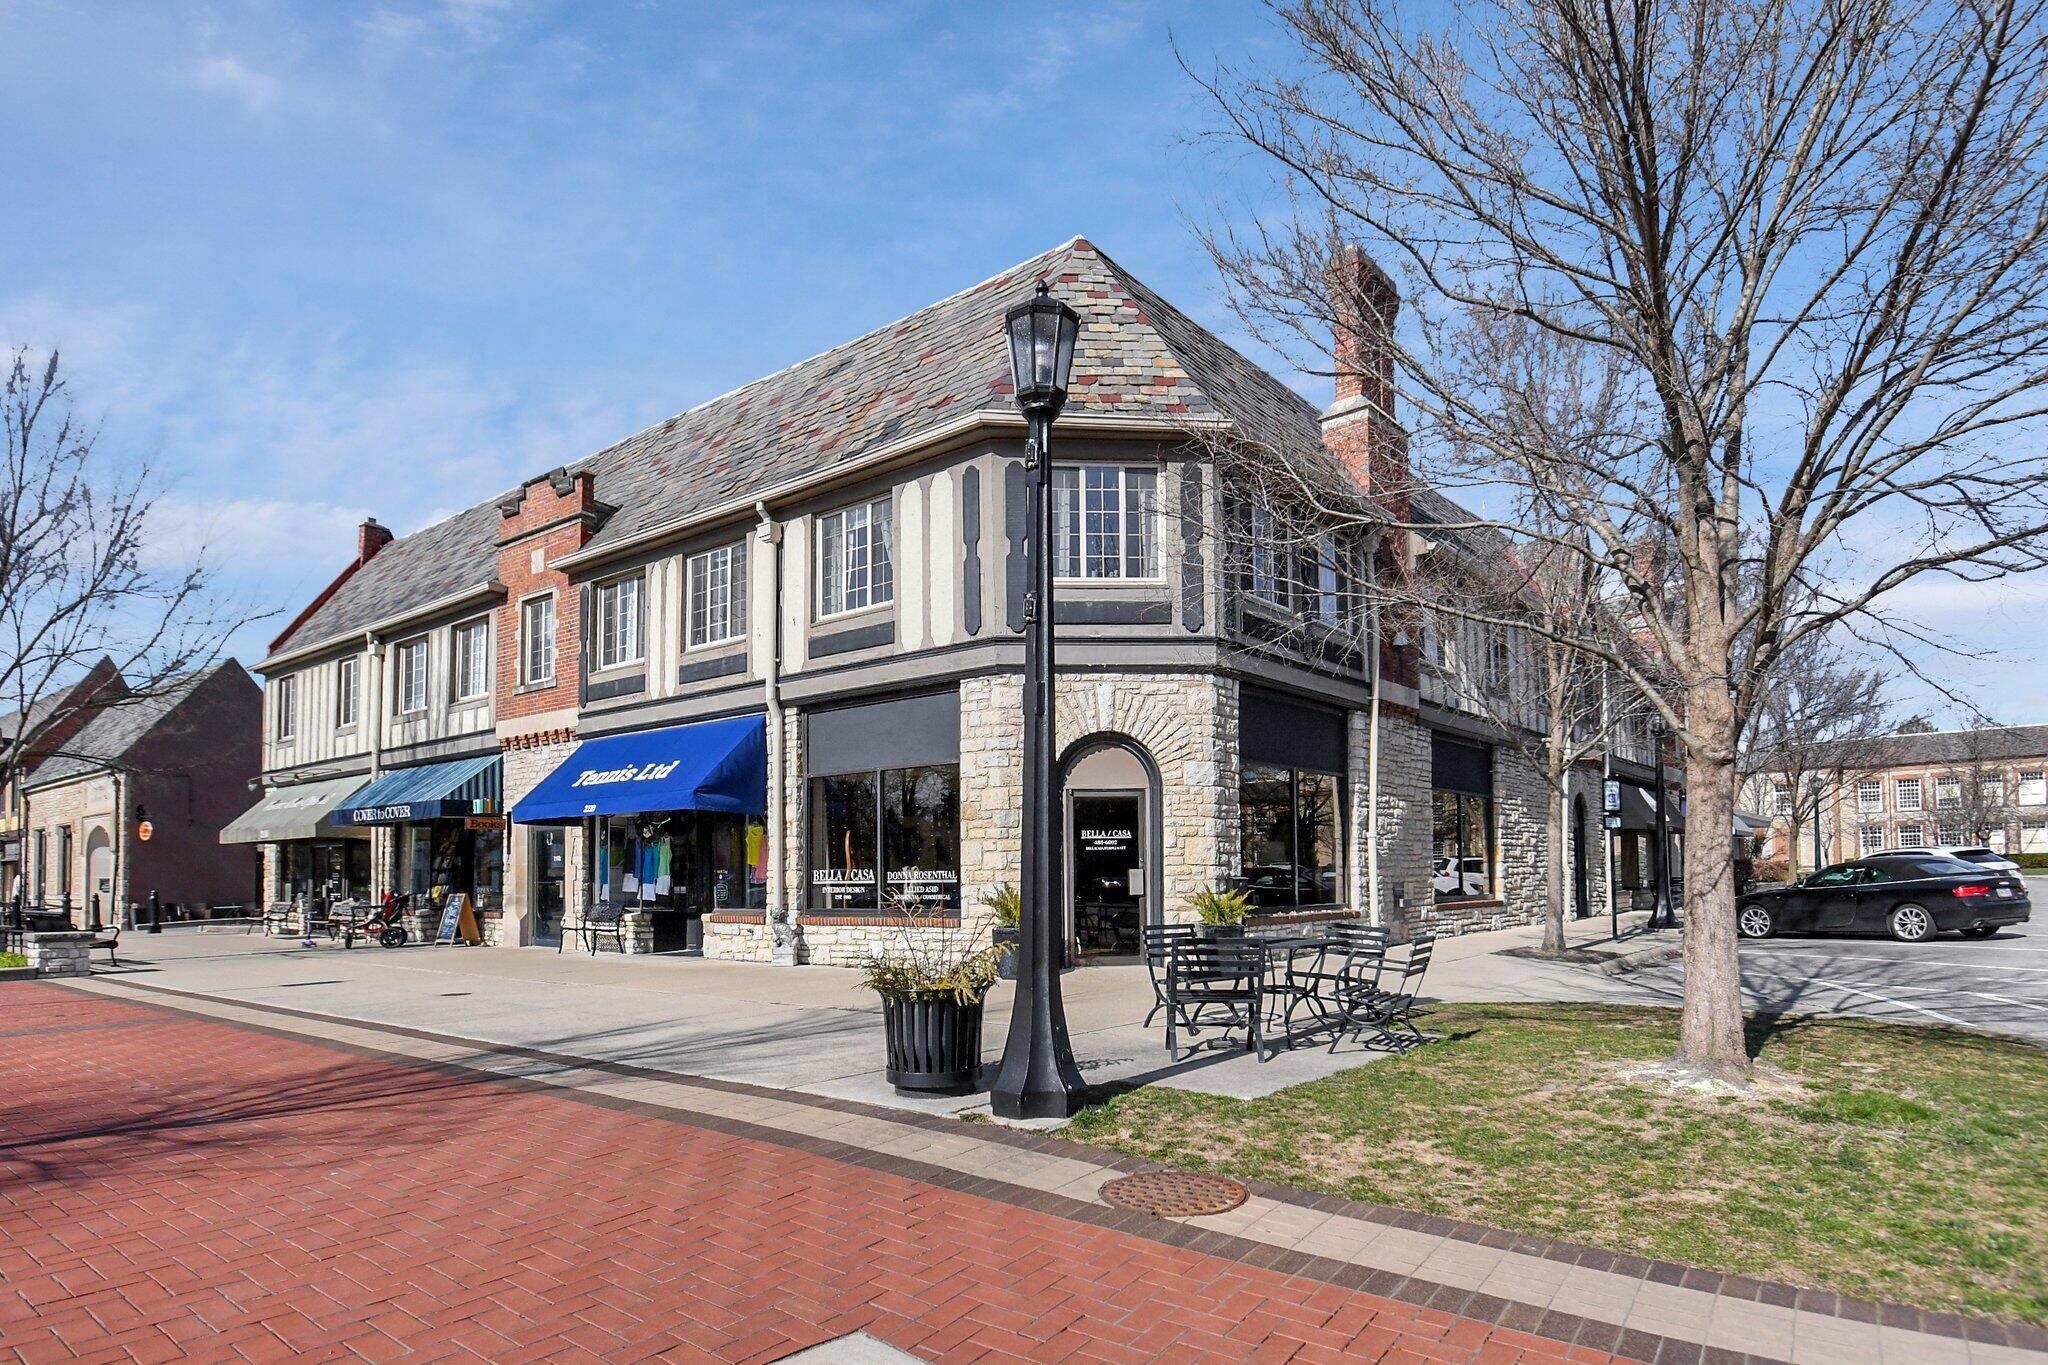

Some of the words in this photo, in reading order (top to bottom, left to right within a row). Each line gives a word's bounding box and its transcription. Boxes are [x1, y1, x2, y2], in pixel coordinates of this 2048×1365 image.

[571, 764, 638, 787] Tennis
[633, 760, 680, 780] Ltd
[353, 809, 377, 822] COVER
[377, 810, 385, 820] to
[384, 805, 411, 818] COVER
[470, 819, 504, 829] Books
[813, 869, 842, 881] BELLA
[850, 869, 874, 881] CASA
[887, 871, 912, 880] DONNA
[913, 870, 957, 880] ROSENTHAL
[822, 886, 845, 894] INTERIOR
[846, 886, 865, 894] DESIGN
